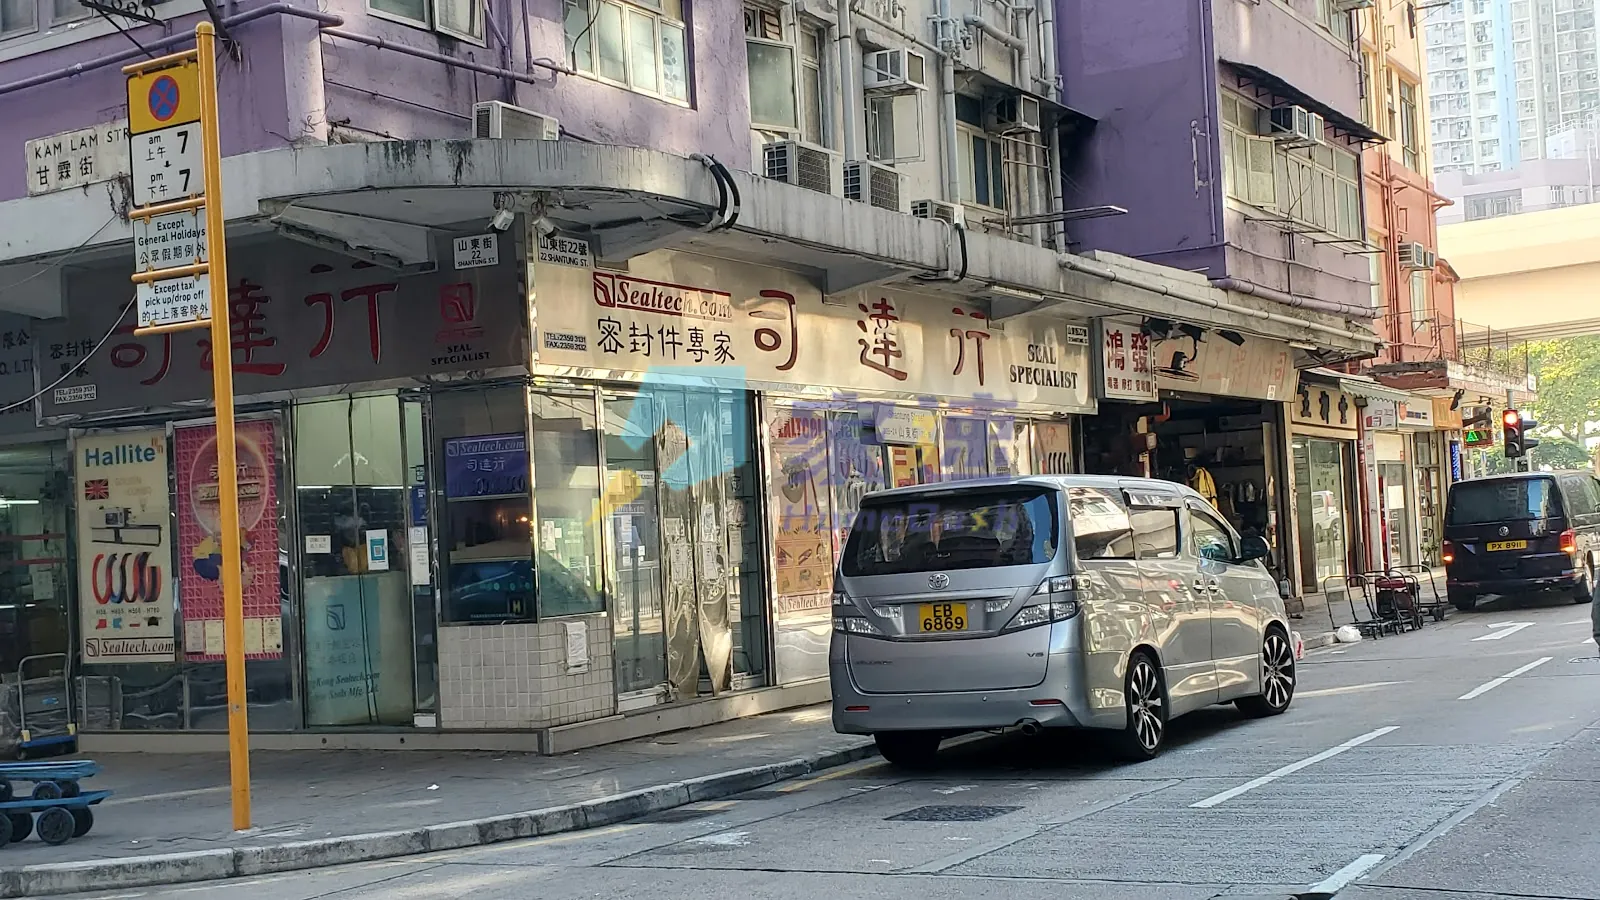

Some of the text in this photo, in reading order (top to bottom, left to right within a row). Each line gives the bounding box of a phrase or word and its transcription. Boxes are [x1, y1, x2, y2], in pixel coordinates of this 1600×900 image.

[35, 142, 62, 159] KAM
[71, 134, 98, 151] LAM
[149, 130, 188, 154] am 7
[145, 146, 166, 161] 上午
[36, 156, 93, 186] 甘霖街
[150, 169, 190, 192] pm 7
[148, 184, 168, 199] 下午
[157, 218, 185, 231] Except
[138, 228, 206, 246] General Holidays
[458, 236, 492, 252] 山東街
[140, 242, 206, 264] 公眾假期例外
[472, 250, 481, 260] 22
[540, 252, 589, 267] 22 SHANTUNG ST.
[458, 258, 487, 267] SHANTUNG
[154, 280, 195, 294] Except taxi
[145, 289, 205, 308] pick up/drop off
[617, 280, 732, 318] Sealtech.com
[142, 303, 209, 322] 的士上落客除外
[597, 315, 736, 364] 密封件專家
[748, 289, 991, 386] 司達行
[50, 337, 96, 360] 密封件
[447, 343, 472, 354] SEAL
[1027, 342, 1057, 365] SEAL
[1106, 328, 1149, 373] 鴻發
[430, 352, 491, 366] SPECIALIST
[1009, 364, 1078, 389] SPECIALIST
[460, 440, 524, 453] Sealtech.com
[85, 443, 156, 468] Hallite
[467, 456, 505, 472] 司達行
[1506, 541, 1522, 549] 8911
[932, 604, 953, 619] EB
[923, 617, 964, 632] 6869
[101, 638, 174, 654] Sealtech.com
